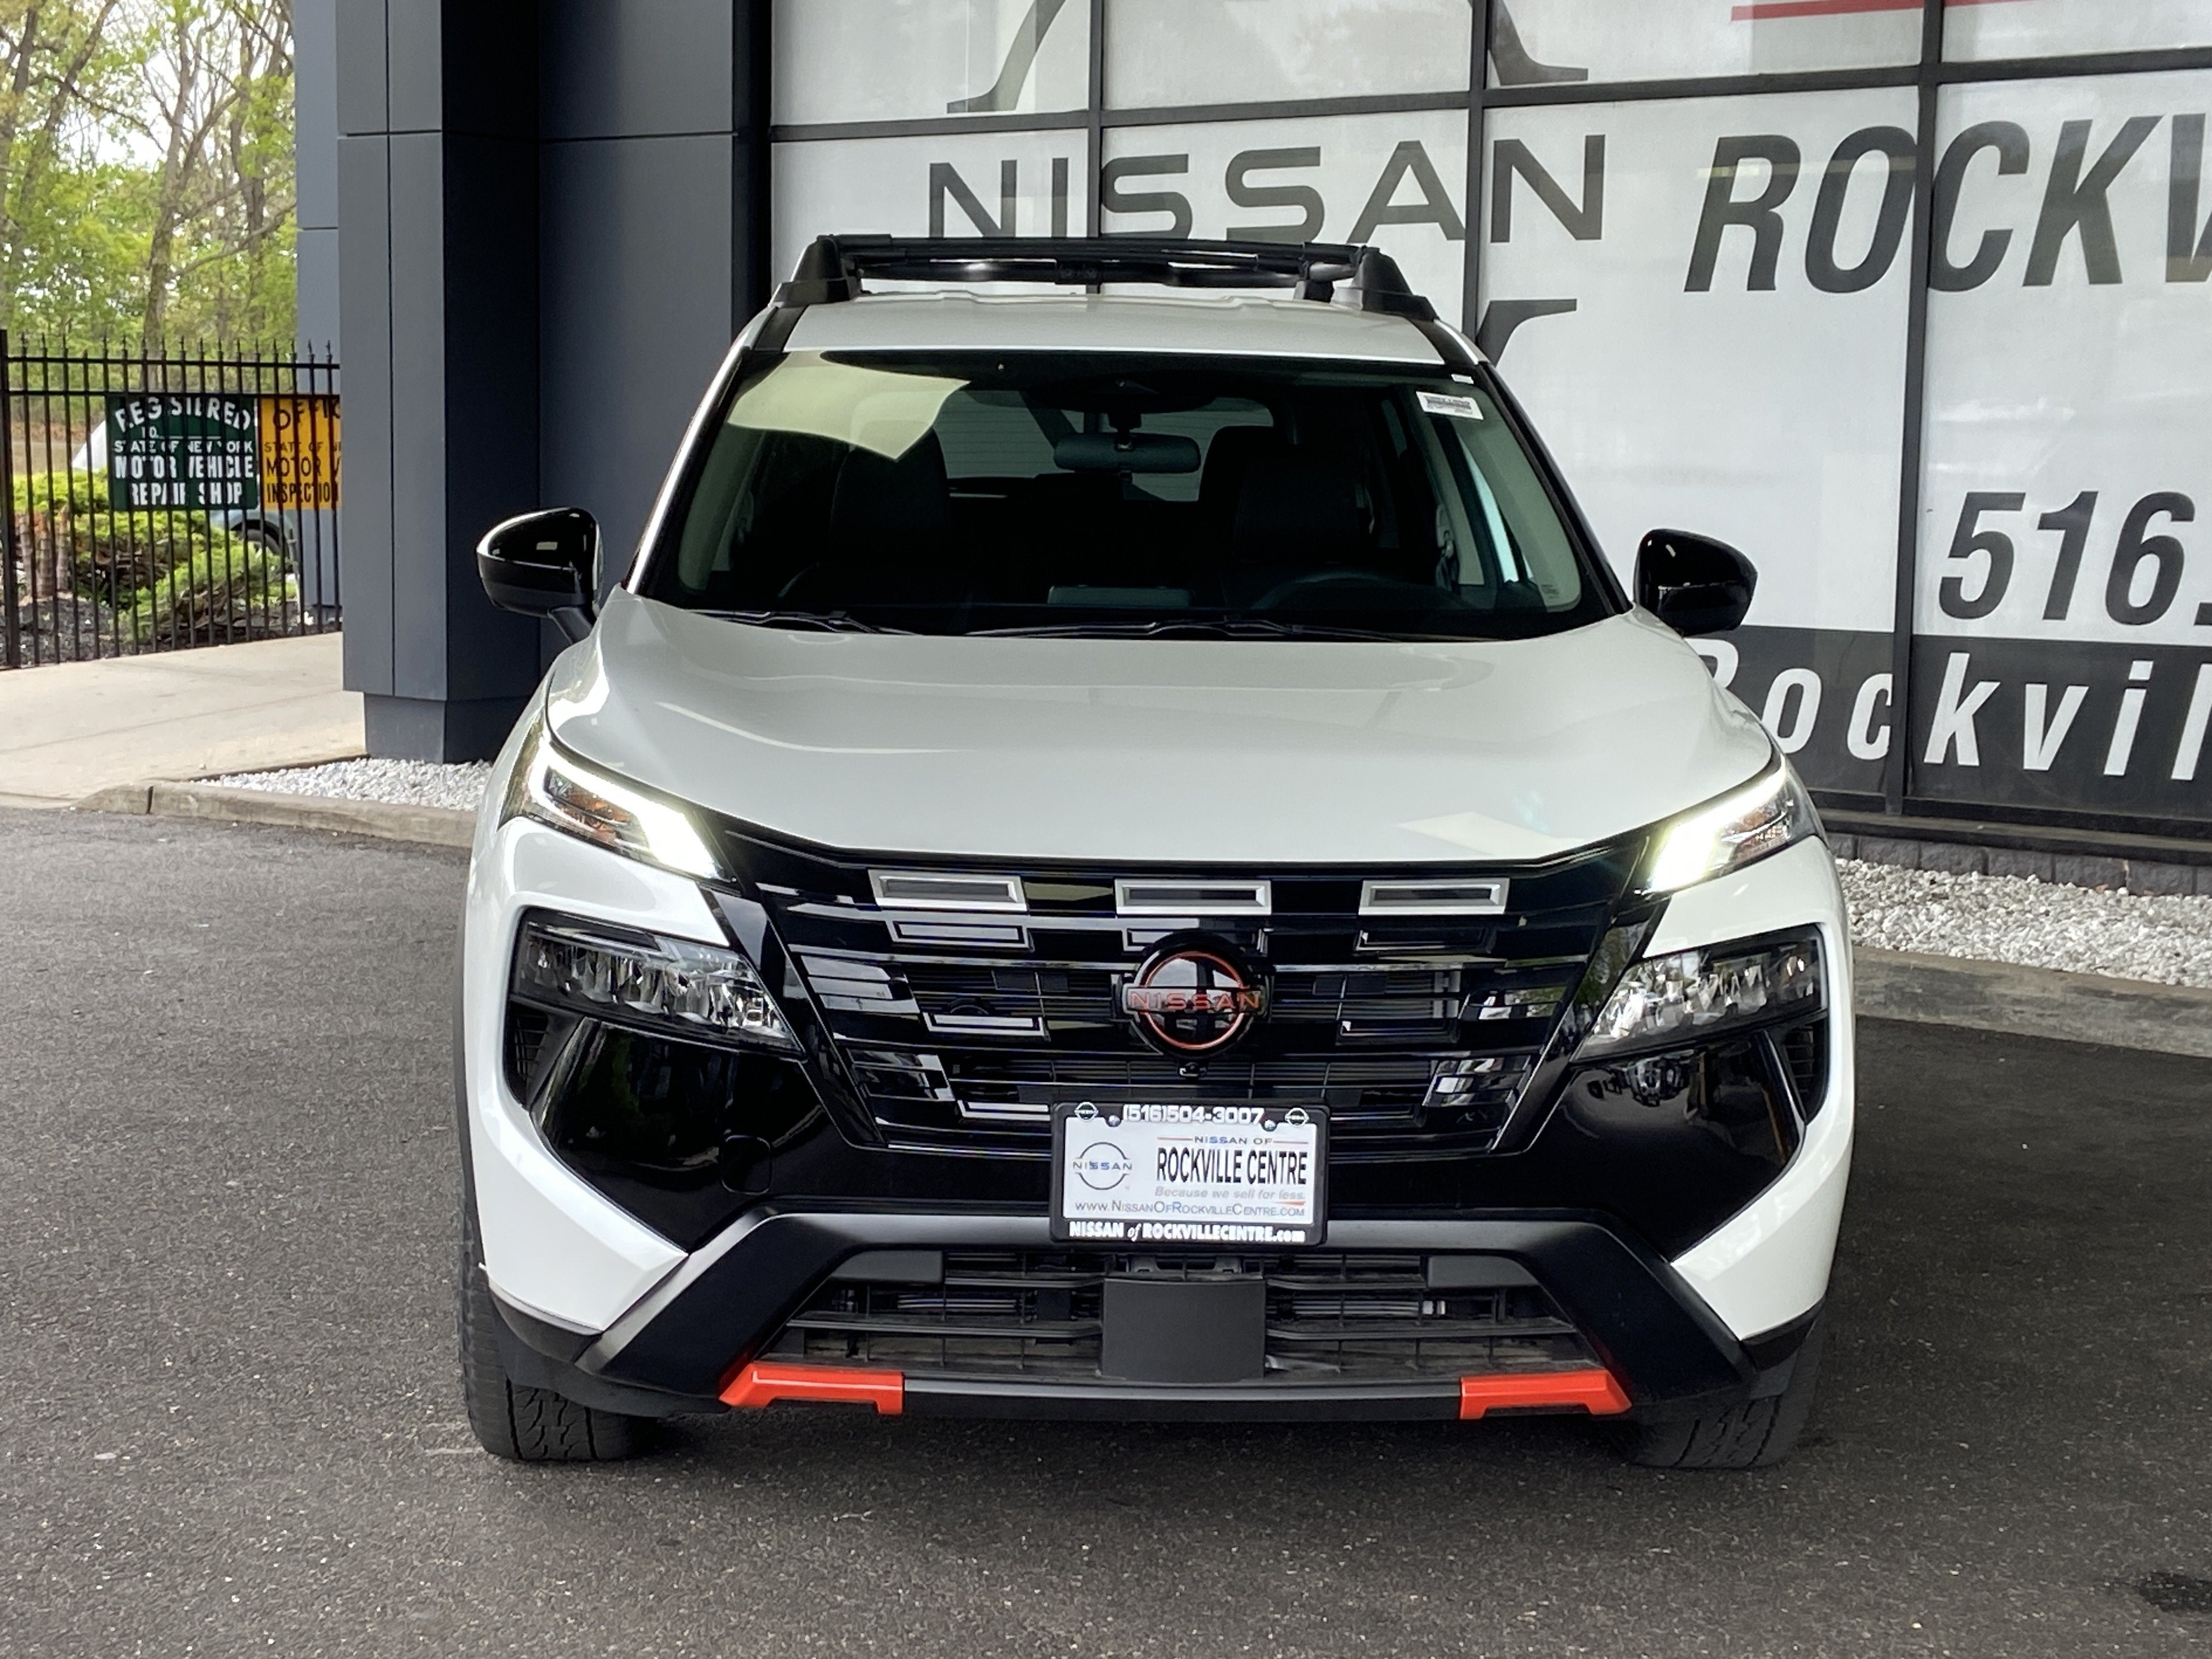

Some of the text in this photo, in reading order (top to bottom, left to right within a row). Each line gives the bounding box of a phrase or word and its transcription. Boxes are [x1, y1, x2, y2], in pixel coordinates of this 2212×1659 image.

[929, 134, 1606, 243] NISSAN
[1684, 113, 2212, 293] ROCKV
[114, 441, 156, 453] SATE
[115, 455, 177, 479] MOOR
[266, 456, 321, 477] MOOR
[1130, 991, 1260, 1011] NISSAN
[1122, 1104, 1264, 1125] (516)504-3007
[1194, 1136, 1248, 1145] NISSAN
[1073, 1161, 1133, 1171] NISSAN
[1156, 1146, 1308, 1185] ROCKVILLE CENTRE
[1155, 1186, 1208, 1198] Because
[1212, 1189, 1230, 1198] we
[1234, 1189, 1255, 1199] sell
[1257, 1189, 1275, 1200] for
[1069, 1221, 1305, 1243] NISSAN of ROCKVILLECENTRE.com
